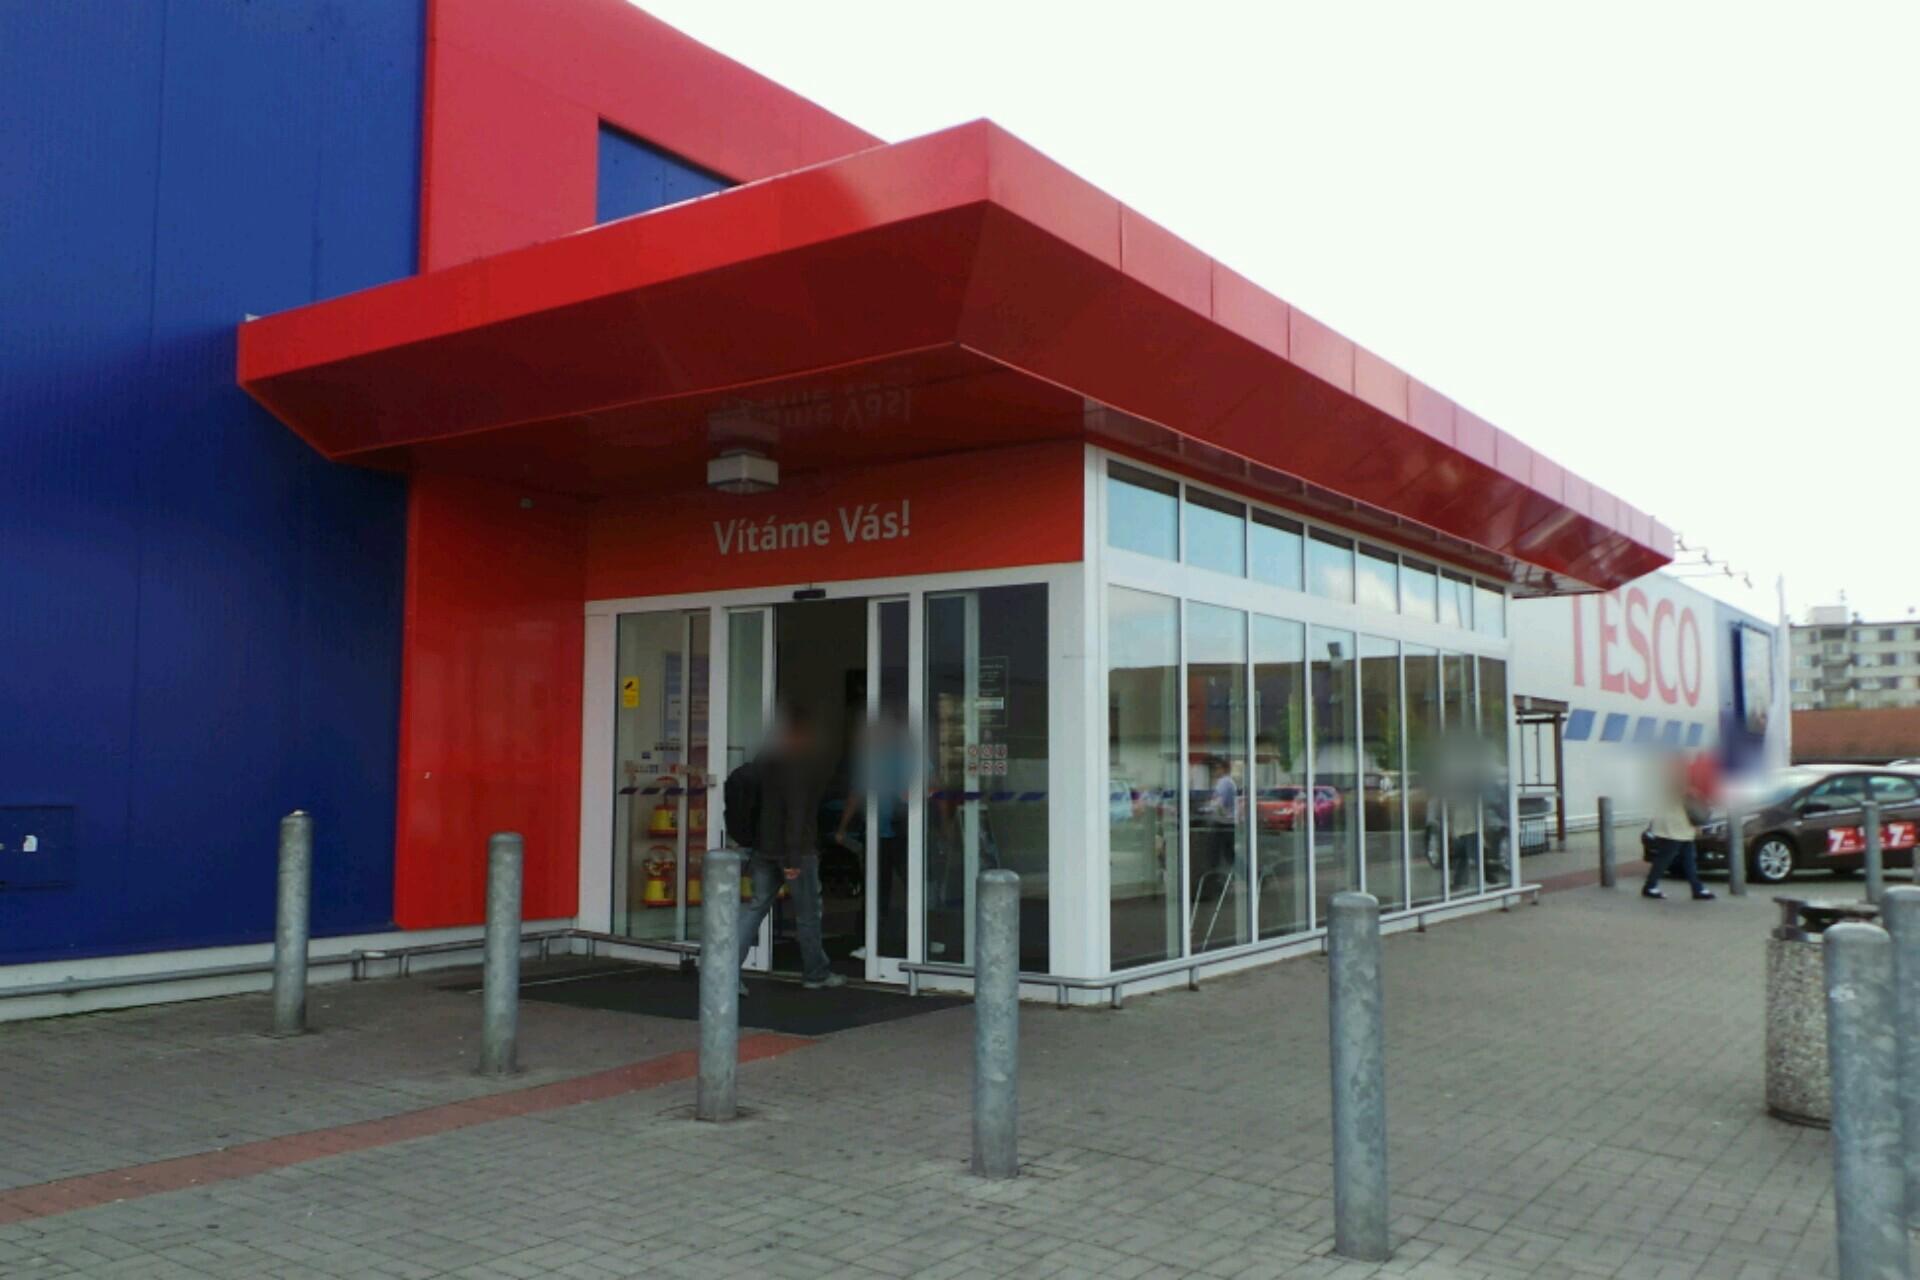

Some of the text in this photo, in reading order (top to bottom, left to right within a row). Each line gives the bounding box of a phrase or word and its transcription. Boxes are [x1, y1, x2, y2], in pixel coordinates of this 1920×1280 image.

[713, 499, 910, 555] Vítáme Vás!
[1828, 829, 1845, 853] 7
[1887, 822, 1905, 846] 7
